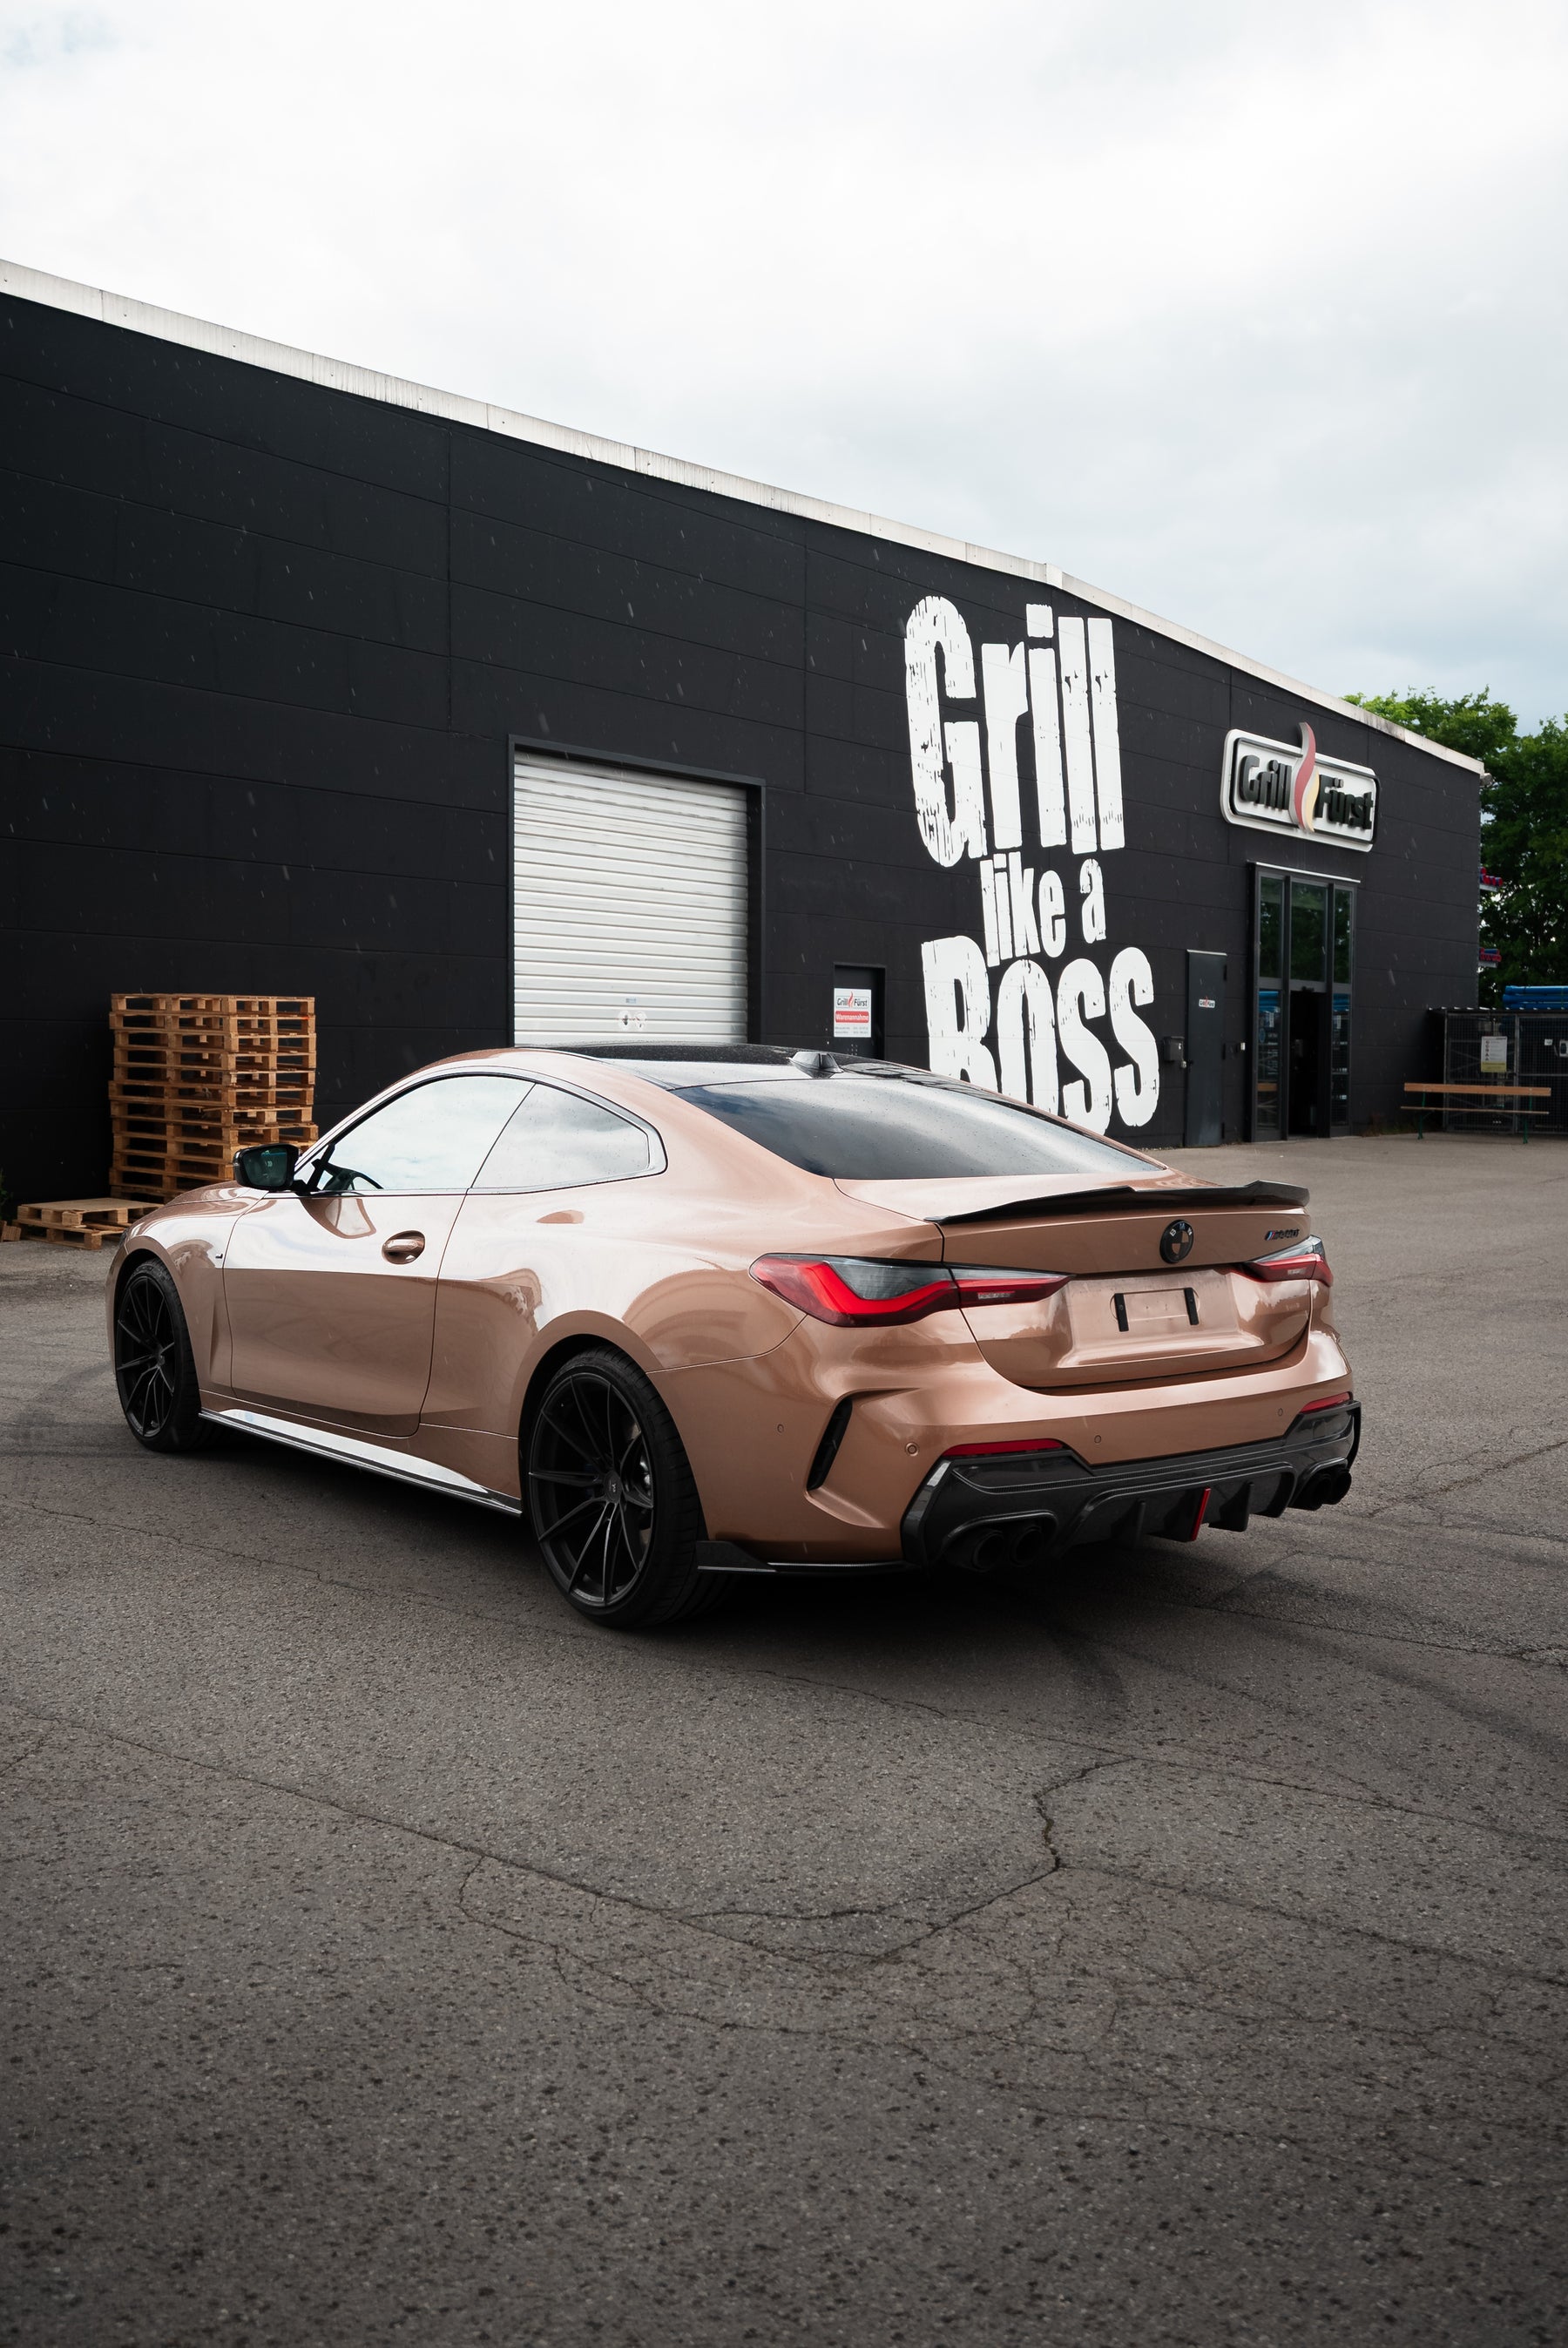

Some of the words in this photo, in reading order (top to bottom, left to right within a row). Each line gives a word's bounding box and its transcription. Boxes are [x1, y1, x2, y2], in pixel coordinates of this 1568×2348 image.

[904, 596, 1125, 868] Grill
[1239, 754, 1293, 811] Grill
[1315, 775, 1374, 830] Fürst
[980, 851, 1066, 967] like
[1080, 858, 1107, 944] a
[1169, 1222, 1193, 1237] BMW
